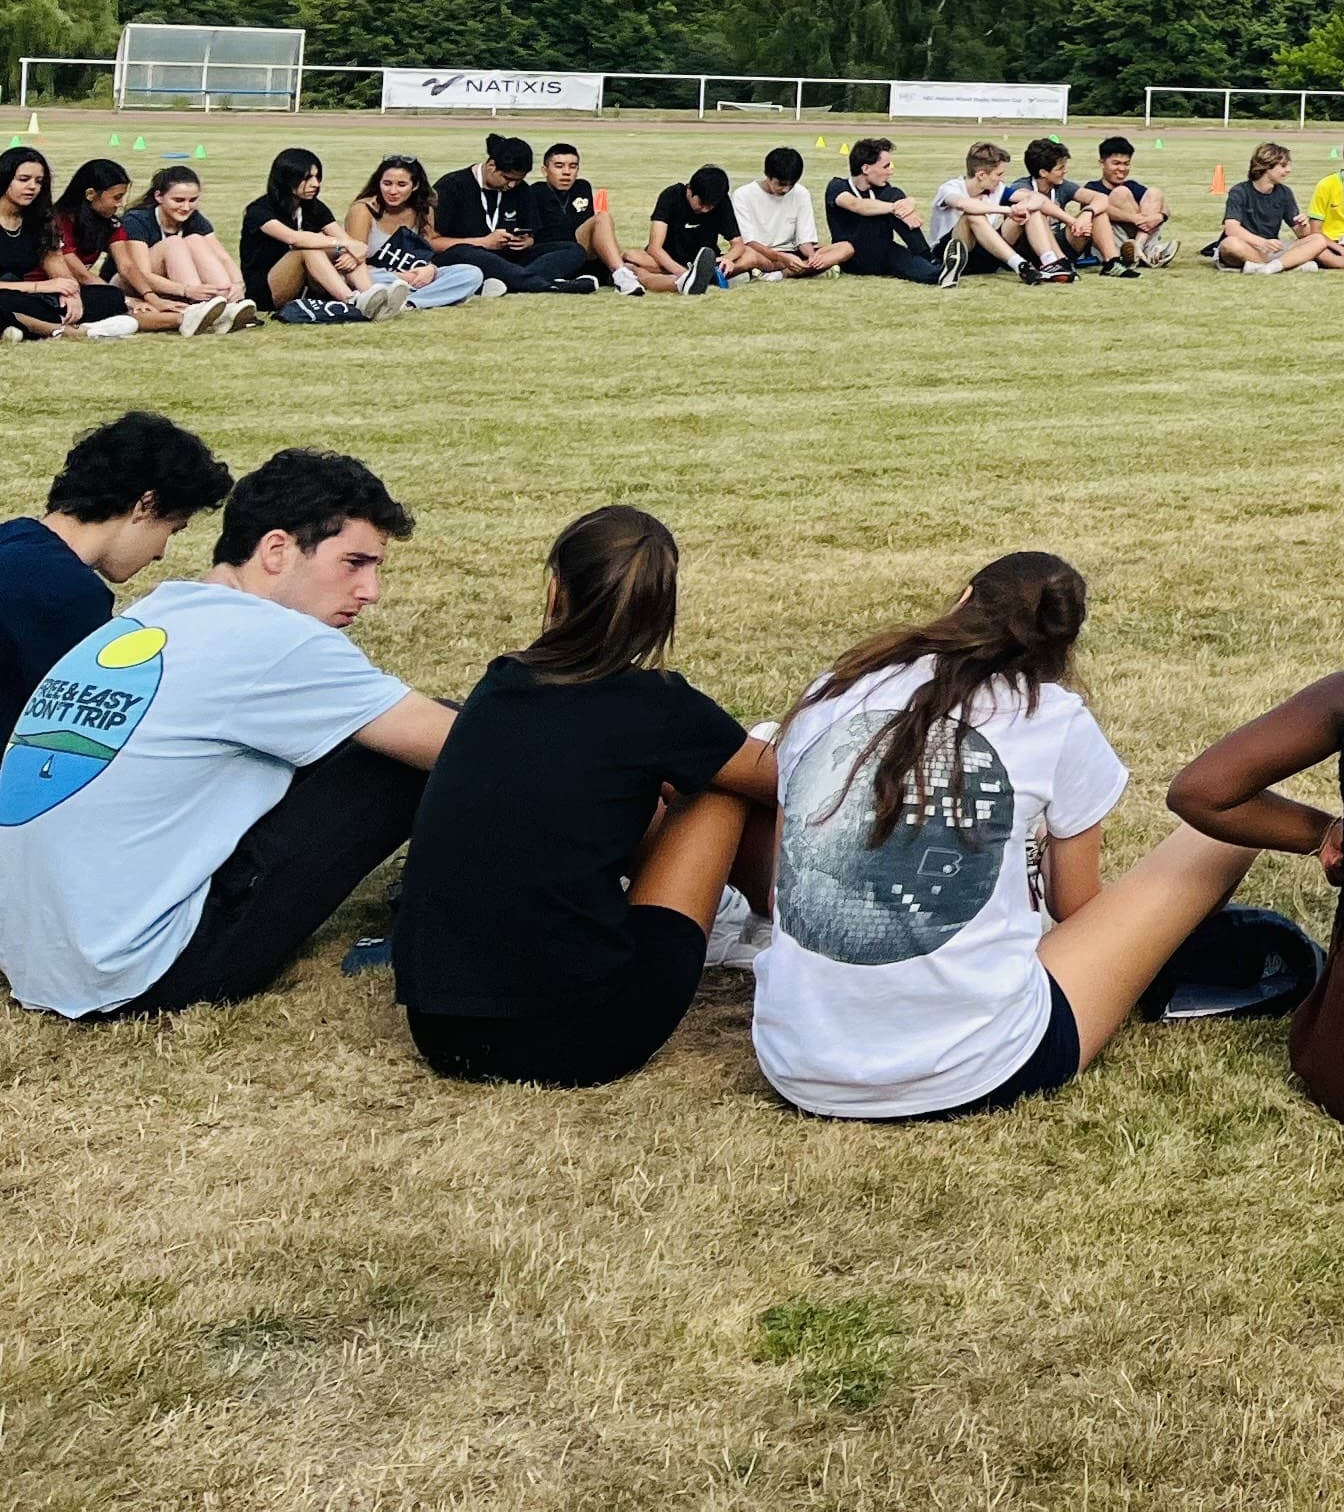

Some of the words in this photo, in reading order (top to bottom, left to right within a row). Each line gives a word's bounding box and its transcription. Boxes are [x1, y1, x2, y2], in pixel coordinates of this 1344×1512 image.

[465, 79, 562, 94] NATIXIS
[62, 682, 80, 701] &
[77, 685, 144, 713] EASY
[72, 705, 127, 730] TRIP
